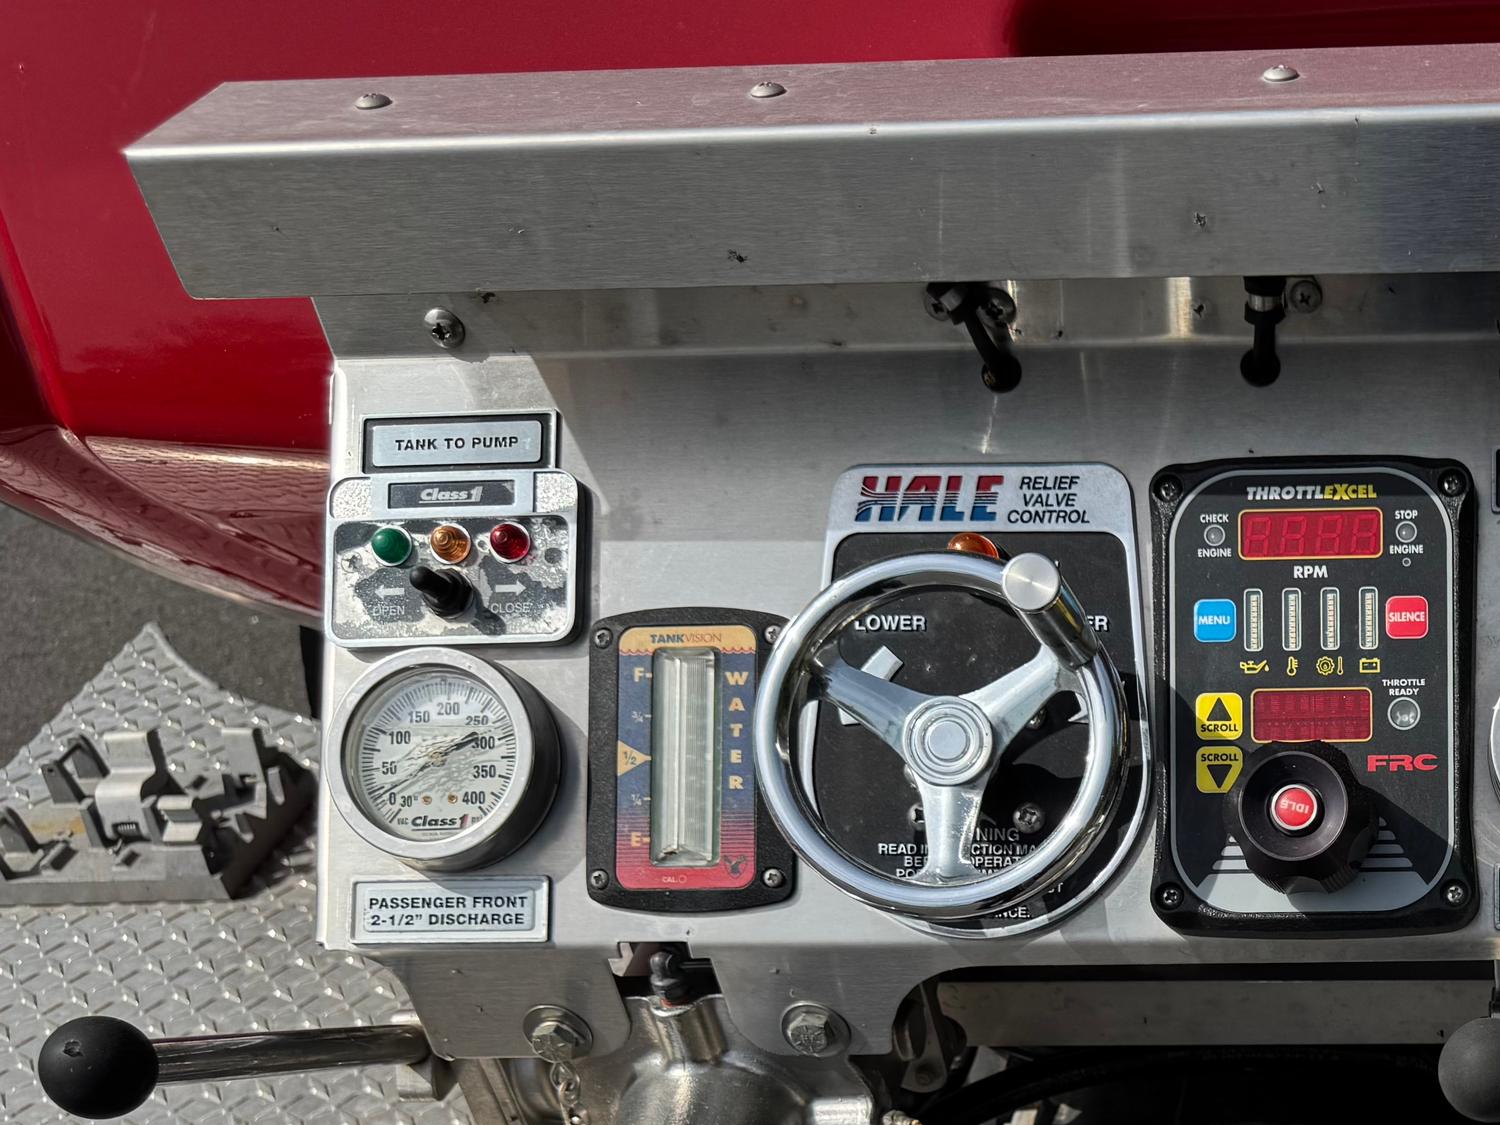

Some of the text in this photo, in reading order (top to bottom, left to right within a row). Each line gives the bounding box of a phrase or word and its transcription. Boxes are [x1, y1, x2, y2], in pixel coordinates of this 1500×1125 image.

[395, 436, 519, 451] TANK TO PUMP
[1020, 476, 1080, 490] RELIEF
[855, 475, 1004, 521] HALE
[1023, 493, 1077, 507] VALVE
[1008, 510, 1090, 523] CONTROL
[1200, 514, 1229, 523] CHECK
[1395, 510, 1418, 519] STOP
[1198, 548, 1231, 558] ENGINE
[1389, 545, 1423, 554] ENGINE
[1293, 565, 1328, 579] RPM
[373, 605, 405, 616] OPEN
[491, 603, 531, 613] CLOSE
[1199, 615, 1230, 624] MENU
[1388, 611, 1425, 622] SILENCE
[855, 615, 926, 632] LOWER
[1382, 678, 1425, 687] THROTTLE
[1389, 687, 1419, 696] READY
[437, 702, 460, 715] 200
[409, 711, 430, 723] 150
[725, 672, 748, 789] WATER
[1201, 723, 1238, 732] SCROLL
[389, 731, 411, 744] 100
[1201, 753, 1238, 761] SCROLL
[1367, 754, 1438, 772] FRC
[382, 762, 397, 775] 50
[473, 765, 496, 778] 350
[463, 791, 485, 804] 400
[1280, 800, 1309, 814] IDLE
[878, 843, 916, 855] READ
[369, 896, 527, 909] PASSENGER FRONT
[429, 914, 524, 925] DISCHARGE
